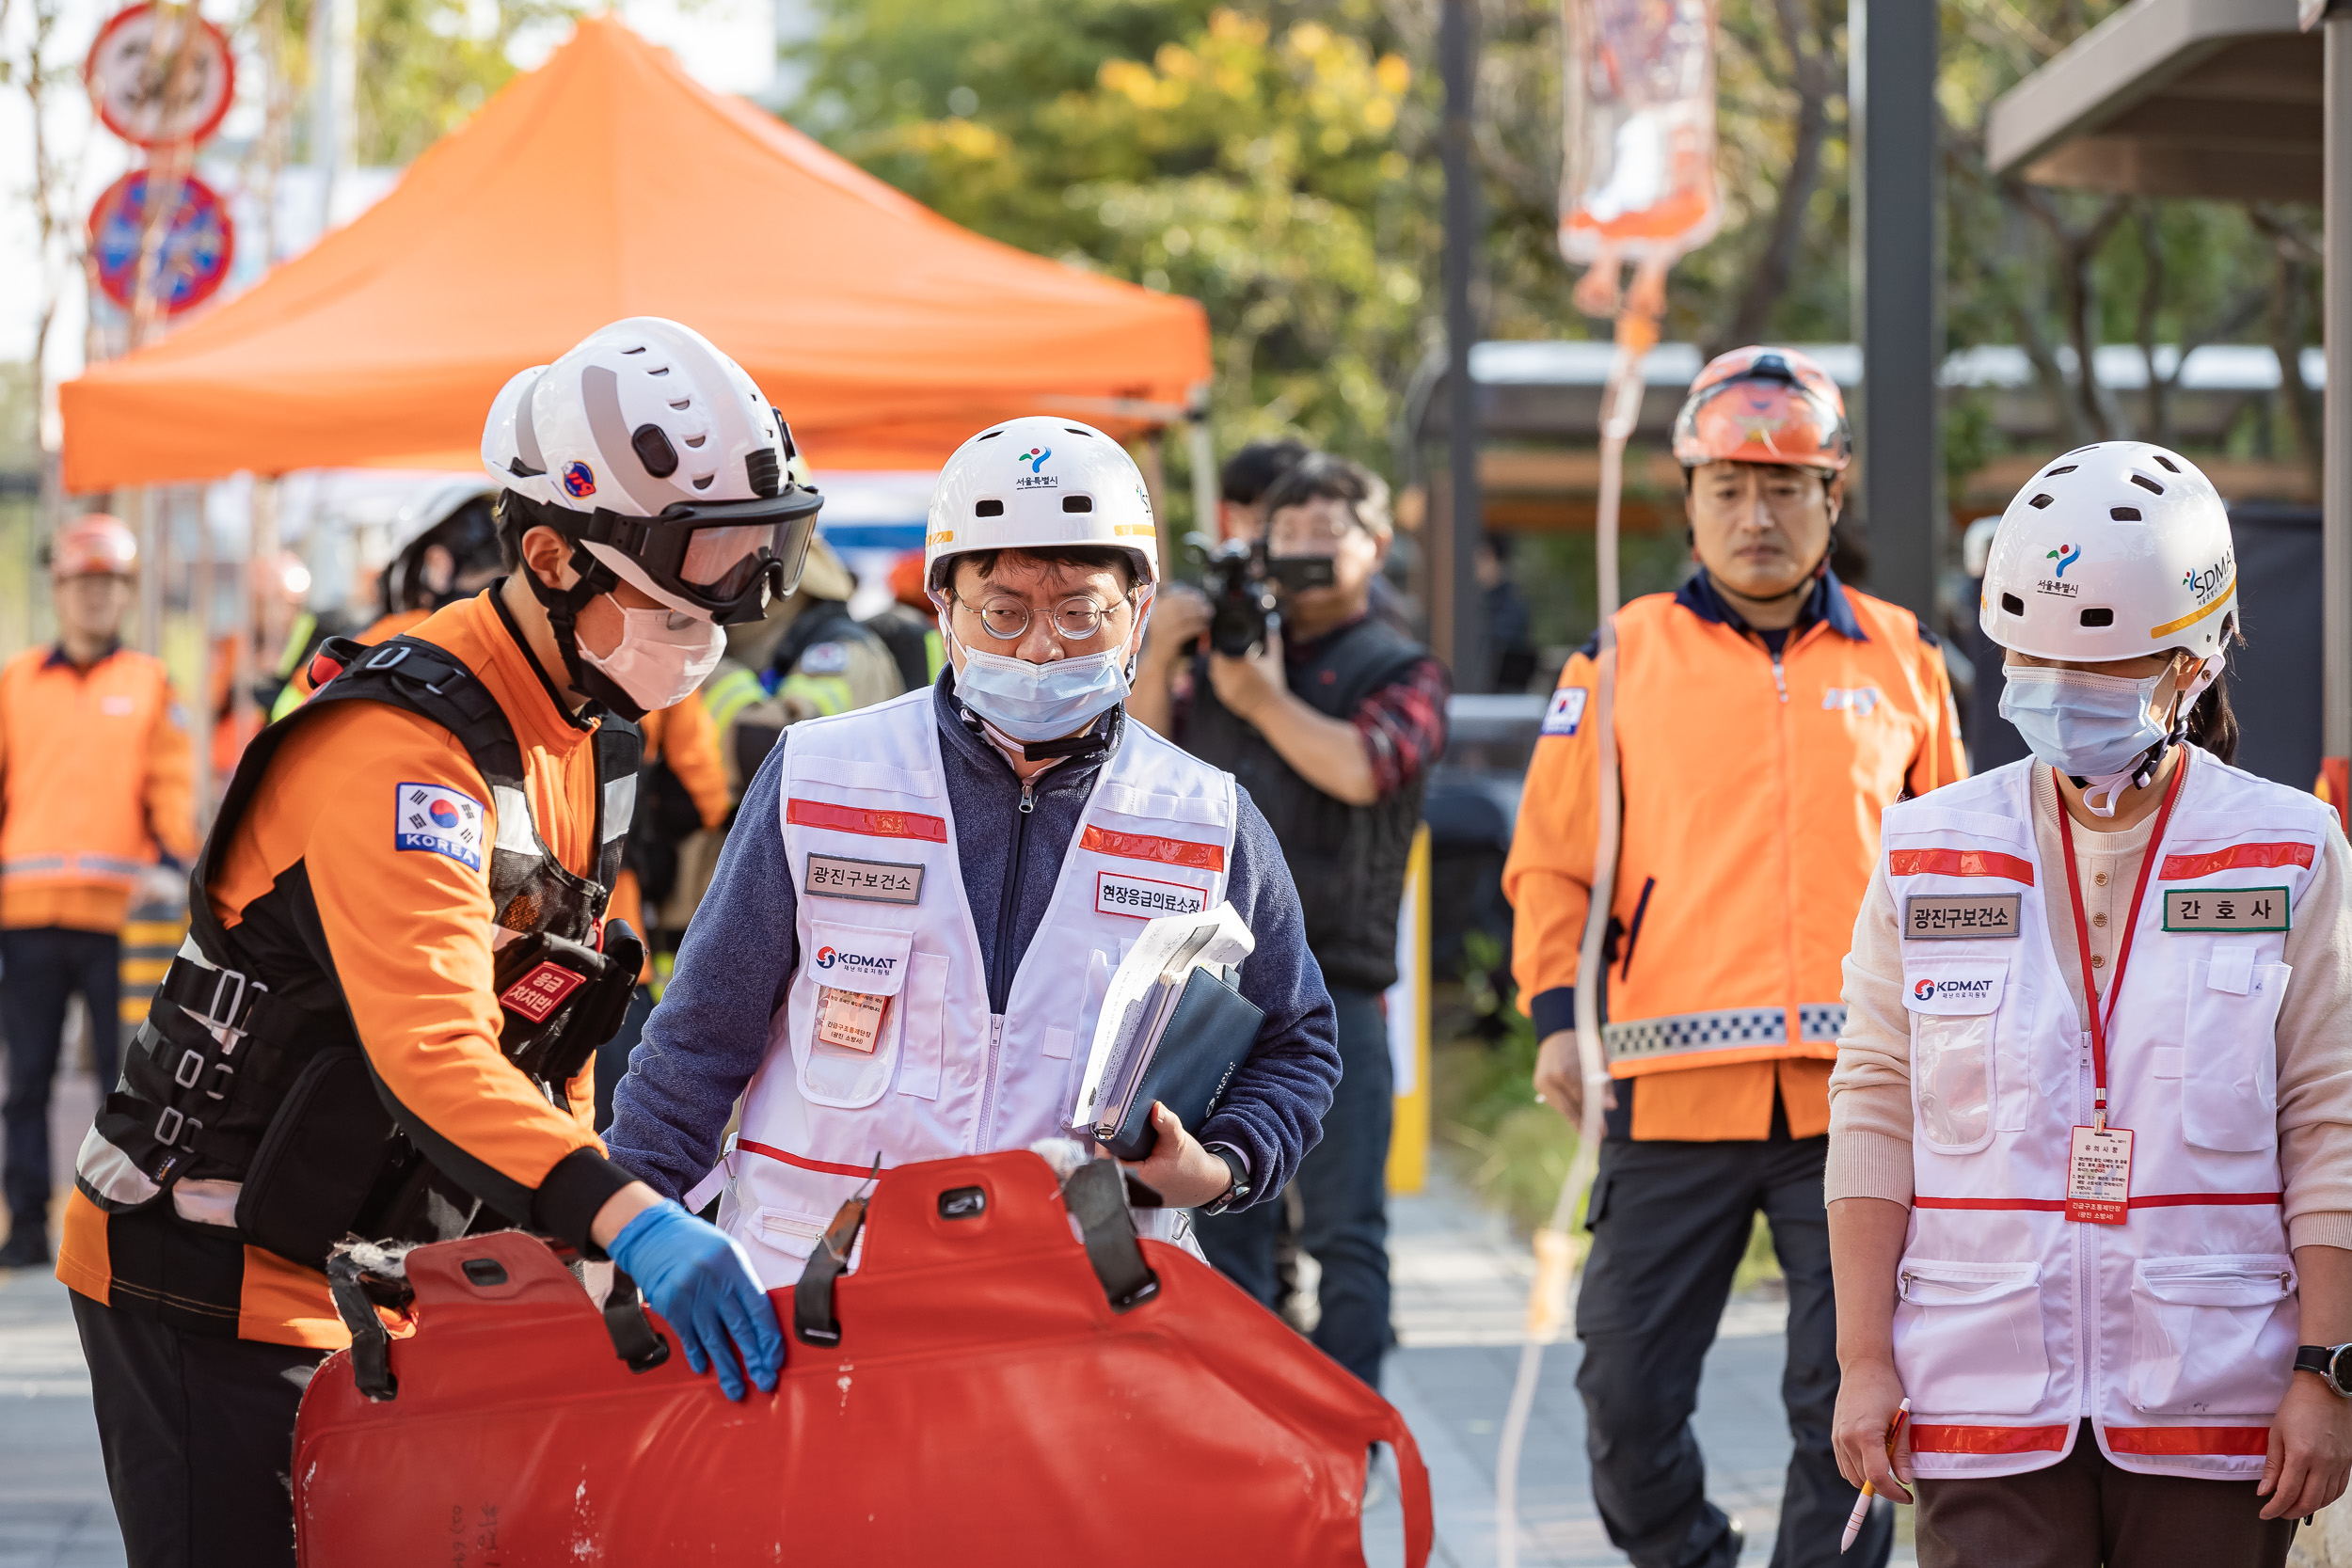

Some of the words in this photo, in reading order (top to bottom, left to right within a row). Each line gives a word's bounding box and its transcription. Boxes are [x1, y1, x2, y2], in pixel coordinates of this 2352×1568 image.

[1016, 476, 1057, 486] 서울특별시
[2038, 579, 2079, 594] 서울특별시
[405, 834, 475, 864] KOREA
[813, 866, 912, 891] 광진구보건소
[1103, 884, 1200, 914] 현장응급의료소장
[1914, 907, 2009, 929] 광진구보건소
[837, 952, 898, 969] KDMAT
[532, 972, 565, 994] 응급
[1936, 980, 1994, 992] KDMAT
[508, 985, 553, 1013] 처치반
